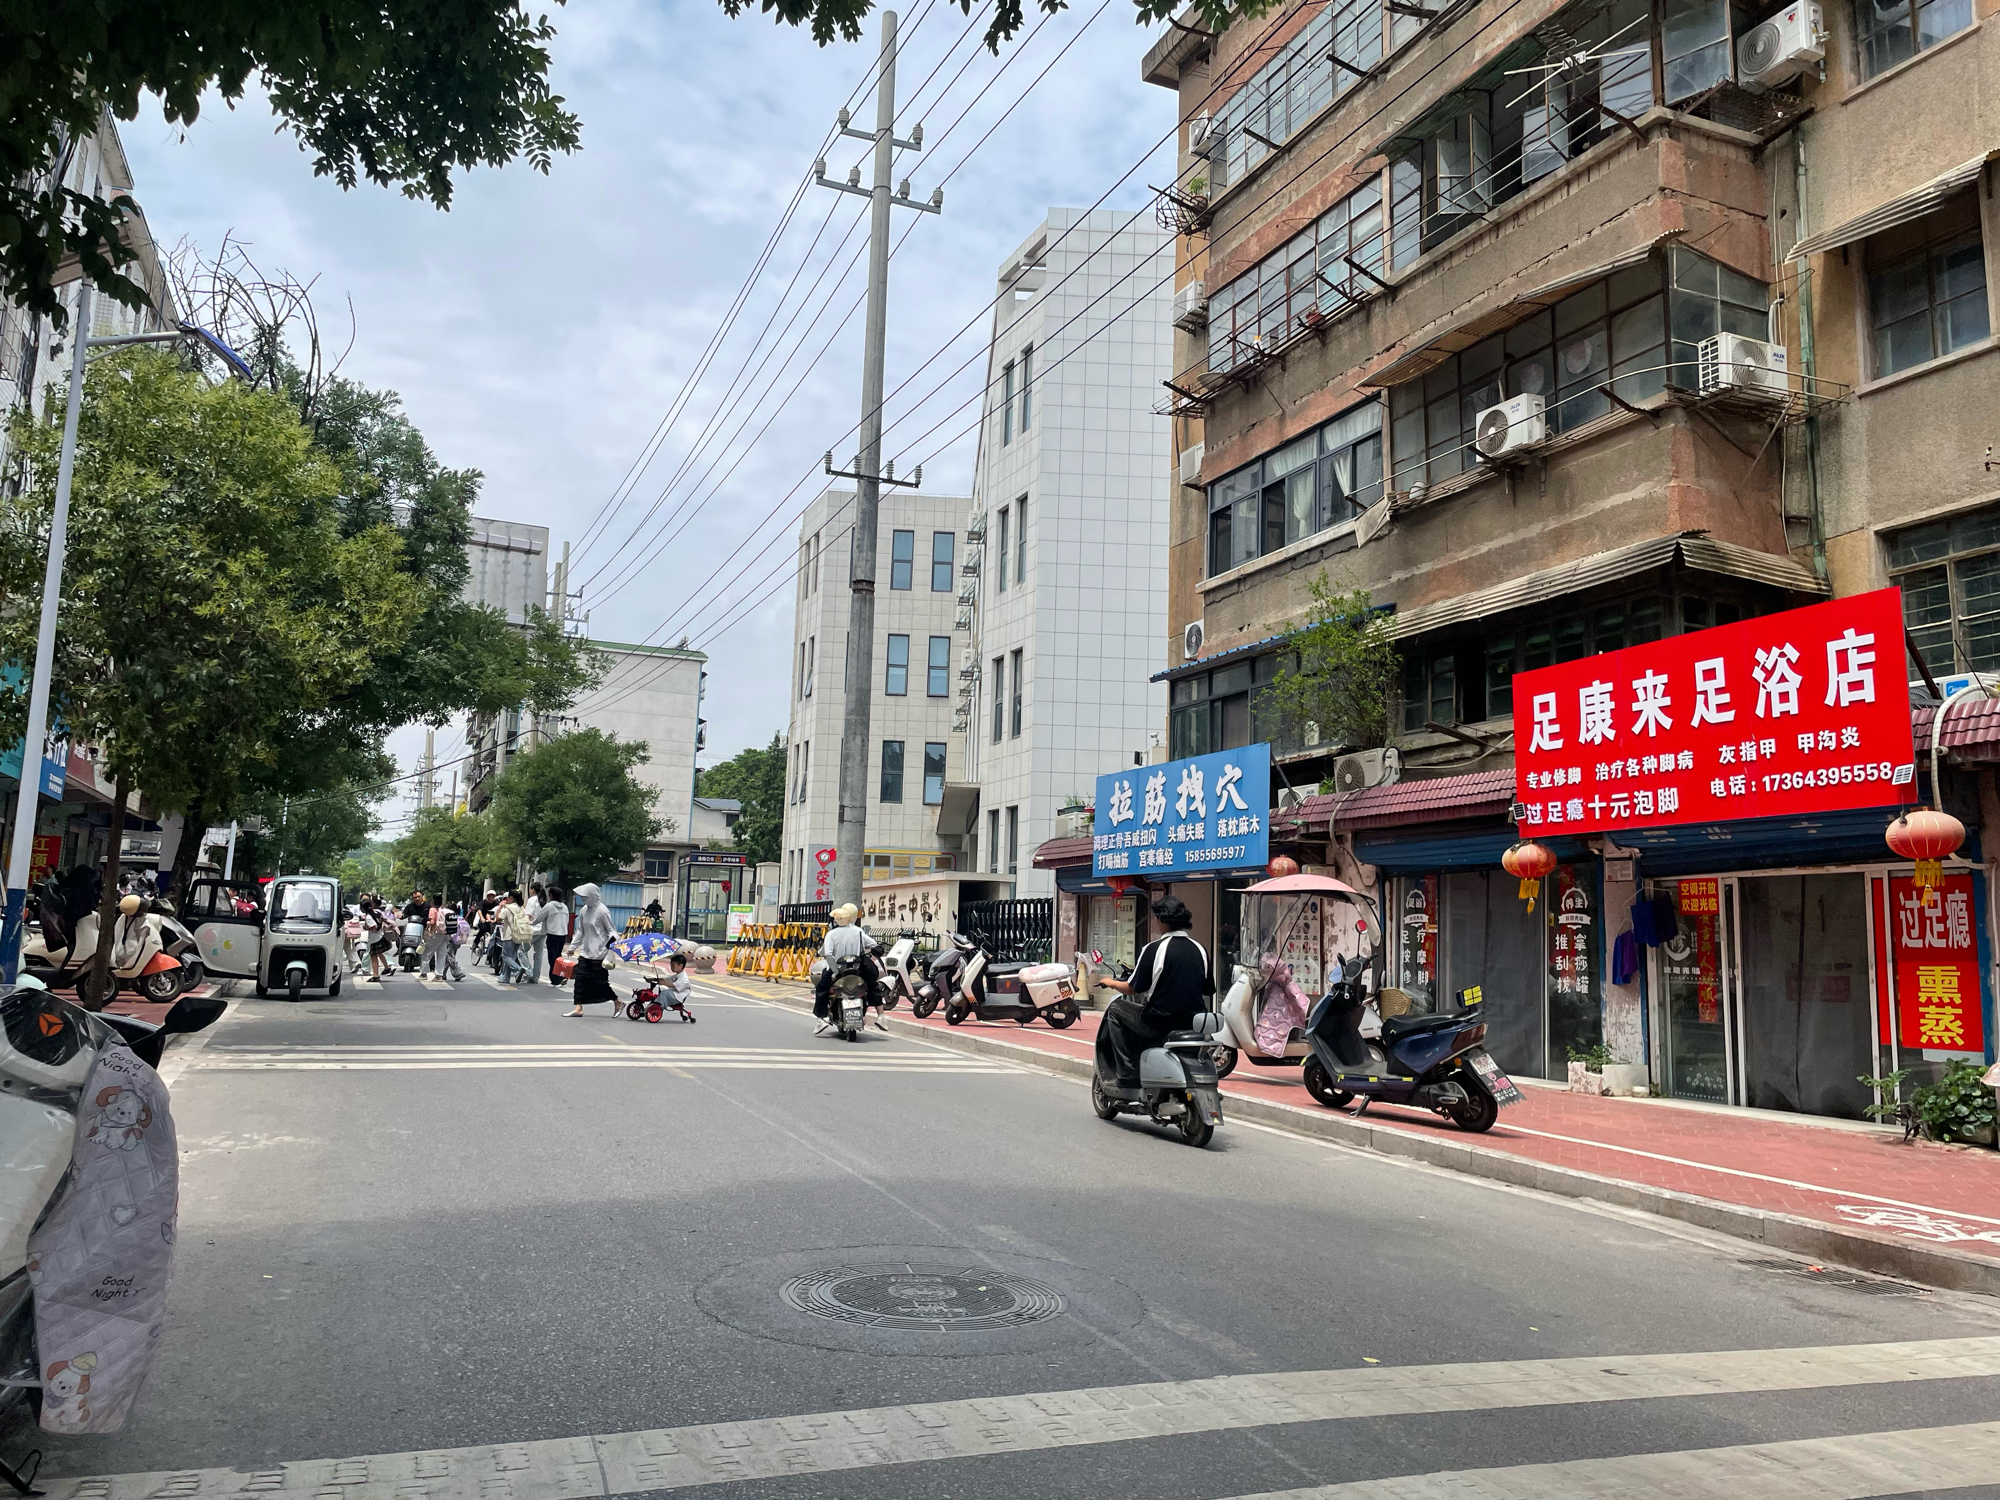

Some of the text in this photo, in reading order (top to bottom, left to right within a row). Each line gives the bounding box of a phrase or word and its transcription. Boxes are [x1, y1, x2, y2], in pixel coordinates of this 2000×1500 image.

[1529, 628, 1876, 754] 足康来足浴店
[1526, 726, 1861, 789] 专业修脚 治疗各种脚病 灰指甲 甲沟炎
[1168, 822, 1205, 844] 头痛失眠
[1217, 814, 1260, 838] 落枕麻木
[1139, 848, 1174, 868] 宫寒痛经
[1185, 845, 1246, 863] 15855695977
[1680, 881, 1717, 896] 空调开放
[1681, 897, 1718, 911] 欢迎光临
[1899, 888, 1971, 949] 过足瘾
[1916, 966, 1964, 1046] 熏蒸
[110, 1052, 144, 1070] Good
[102, 1275, 134, 1287] Good
[91, 1288, 130, 1302] Night
